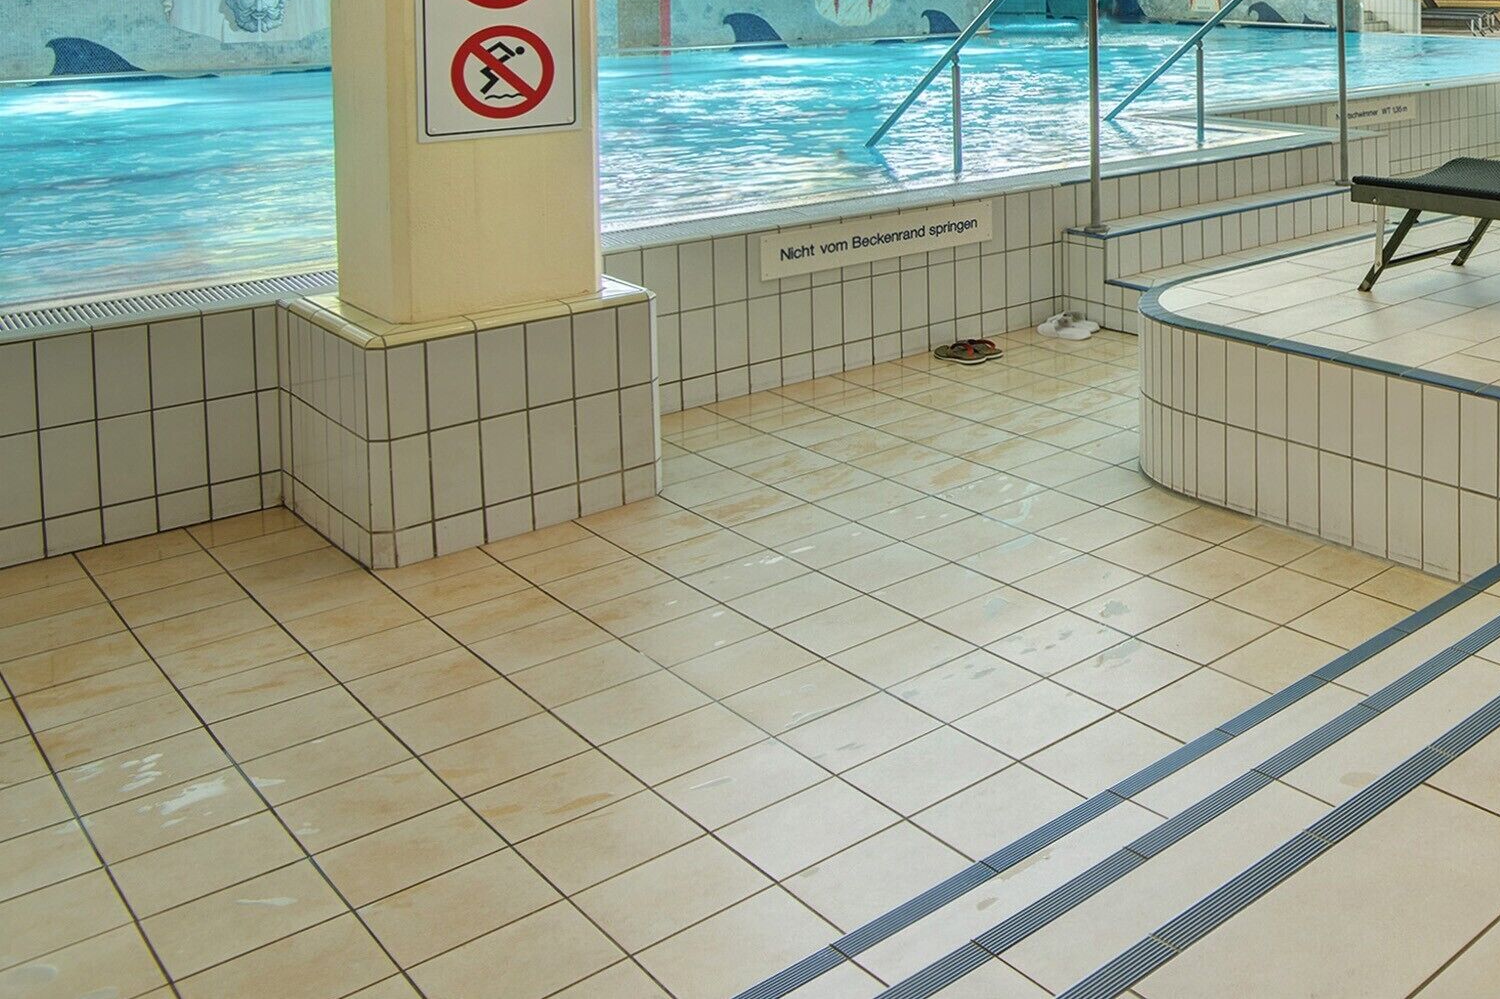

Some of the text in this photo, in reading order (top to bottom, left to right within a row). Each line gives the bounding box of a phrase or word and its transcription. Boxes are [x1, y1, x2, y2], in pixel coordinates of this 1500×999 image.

[779, 217, 978, 262] Nicht vom Beckenrand springen
